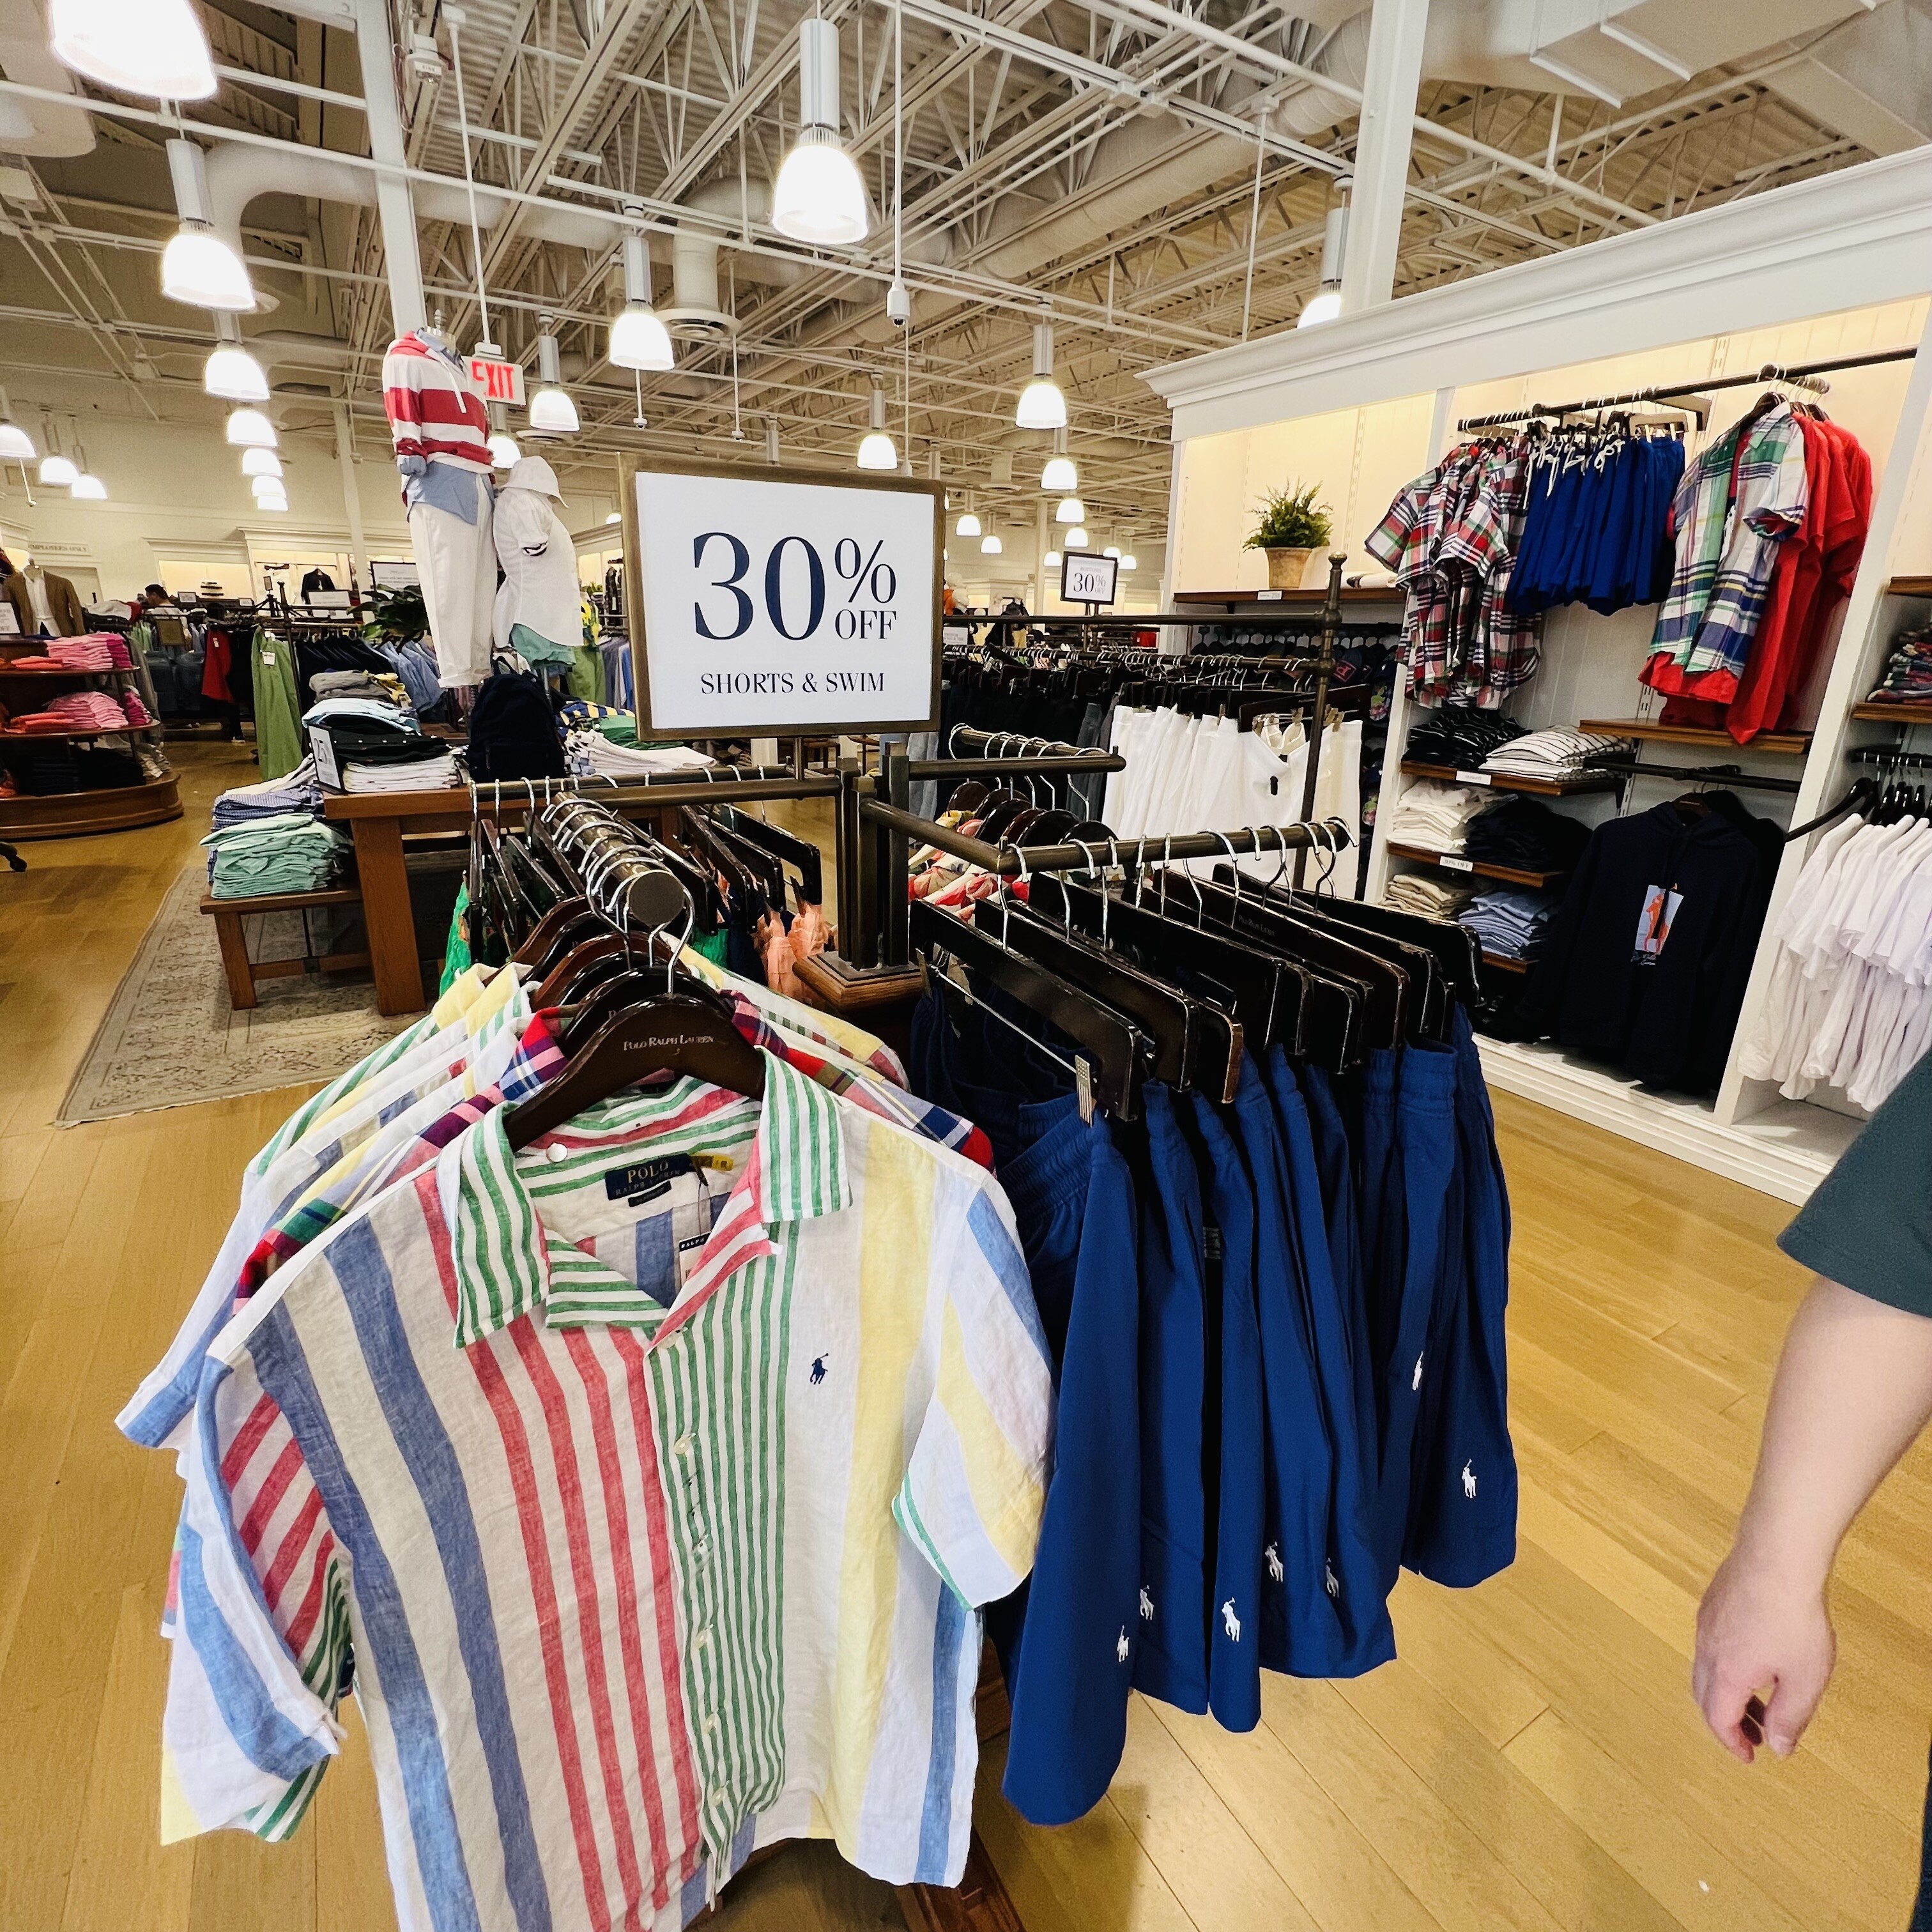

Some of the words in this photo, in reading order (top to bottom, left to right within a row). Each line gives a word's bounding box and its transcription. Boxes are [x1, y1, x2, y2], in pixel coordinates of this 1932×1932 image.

[471, 360, 514, 399] EXIT
[693, 532, 897, 641] 30%
[1073, 572, 1107, 594] 30%
[834, 609, 897, 640] OFF
[701, 673, 793, 694] SHORTS
[802, 672, 818, 693] &
[825, 672, 885, 693] SWIM
[624, 1041, 647, 1051] POLO
[648, 1036, 678, 1047] RALPH
[680, 1034, 714, 1045] LAUREN
[627, 1160, 669, 1183] POLO
